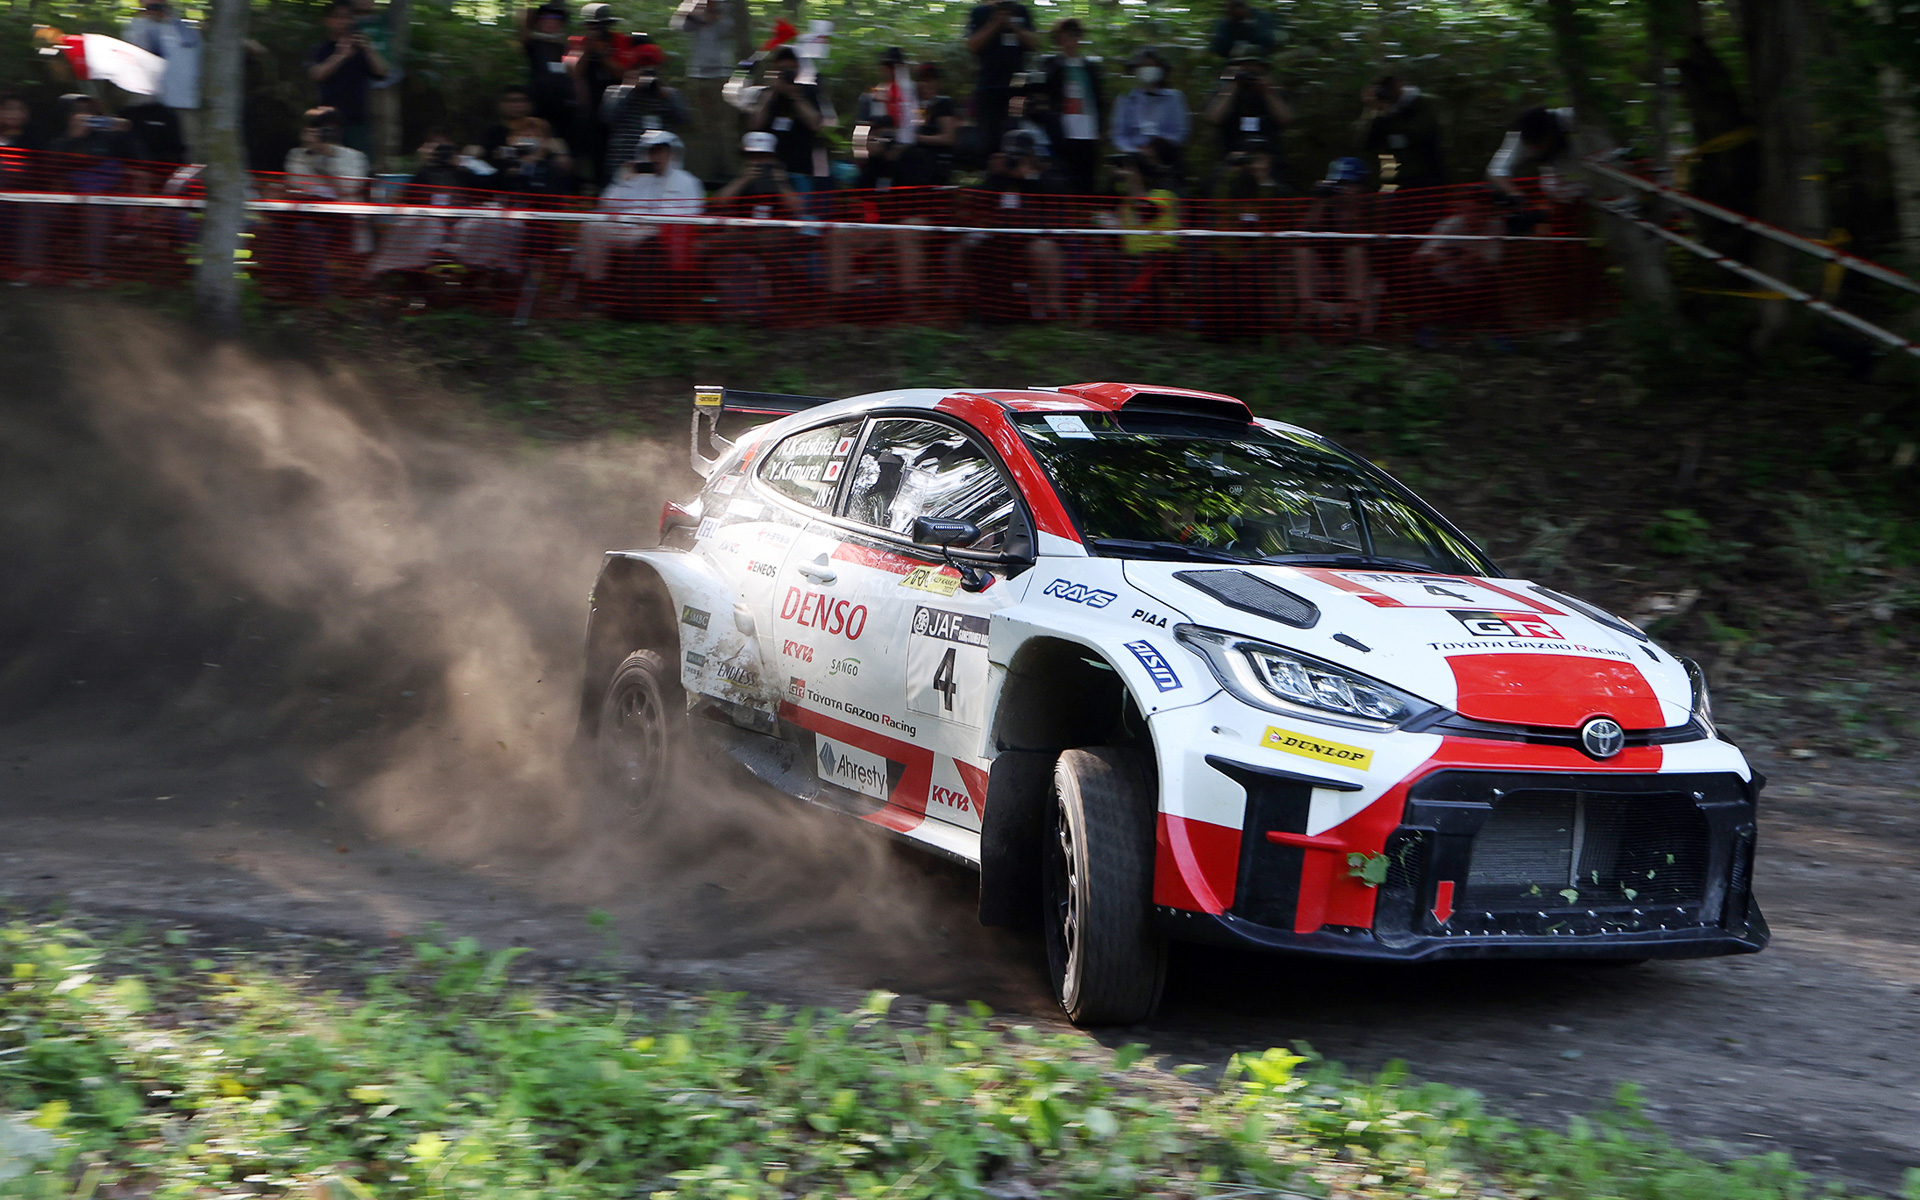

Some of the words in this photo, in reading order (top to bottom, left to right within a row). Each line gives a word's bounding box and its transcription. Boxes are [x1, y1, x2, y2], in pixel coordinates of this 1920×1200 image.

[769, 461, 820, 480] Y.Kimura
[812, 486, 836, 507] JN1
[752, 562, 777, 578] ENEOS
[1043, 578, 1118, 609] RAYS
[1423, 584, 1475, 603] 4
[780, 586, 867, 641] DENSO
[929, 612, 962, 639] JAF
[1131, 608, 1168, 629] PIAA
[1463, 617, 1560, 639] GR
[1427, 641, 1504, 651] TOYOTA
[1508, 640, 1571, 651] GAZOO
[1574, 644, 1631, 660] Racing
[717, 662, 757, 686] ENDLESS
[831, 658, 859, 677] SANGO
[1124, 640, 1179, 690] AISIN
[933, 647, 957, 712] 4
[807, 689, 843, 711] TOYOTA
[844, 702, 880, 723] GAZOO
[881, 714, 917, 738] Racing
[1282, 736, 1366, 762] DUNLOP
[836, 753, 886, 796] Ahresty
